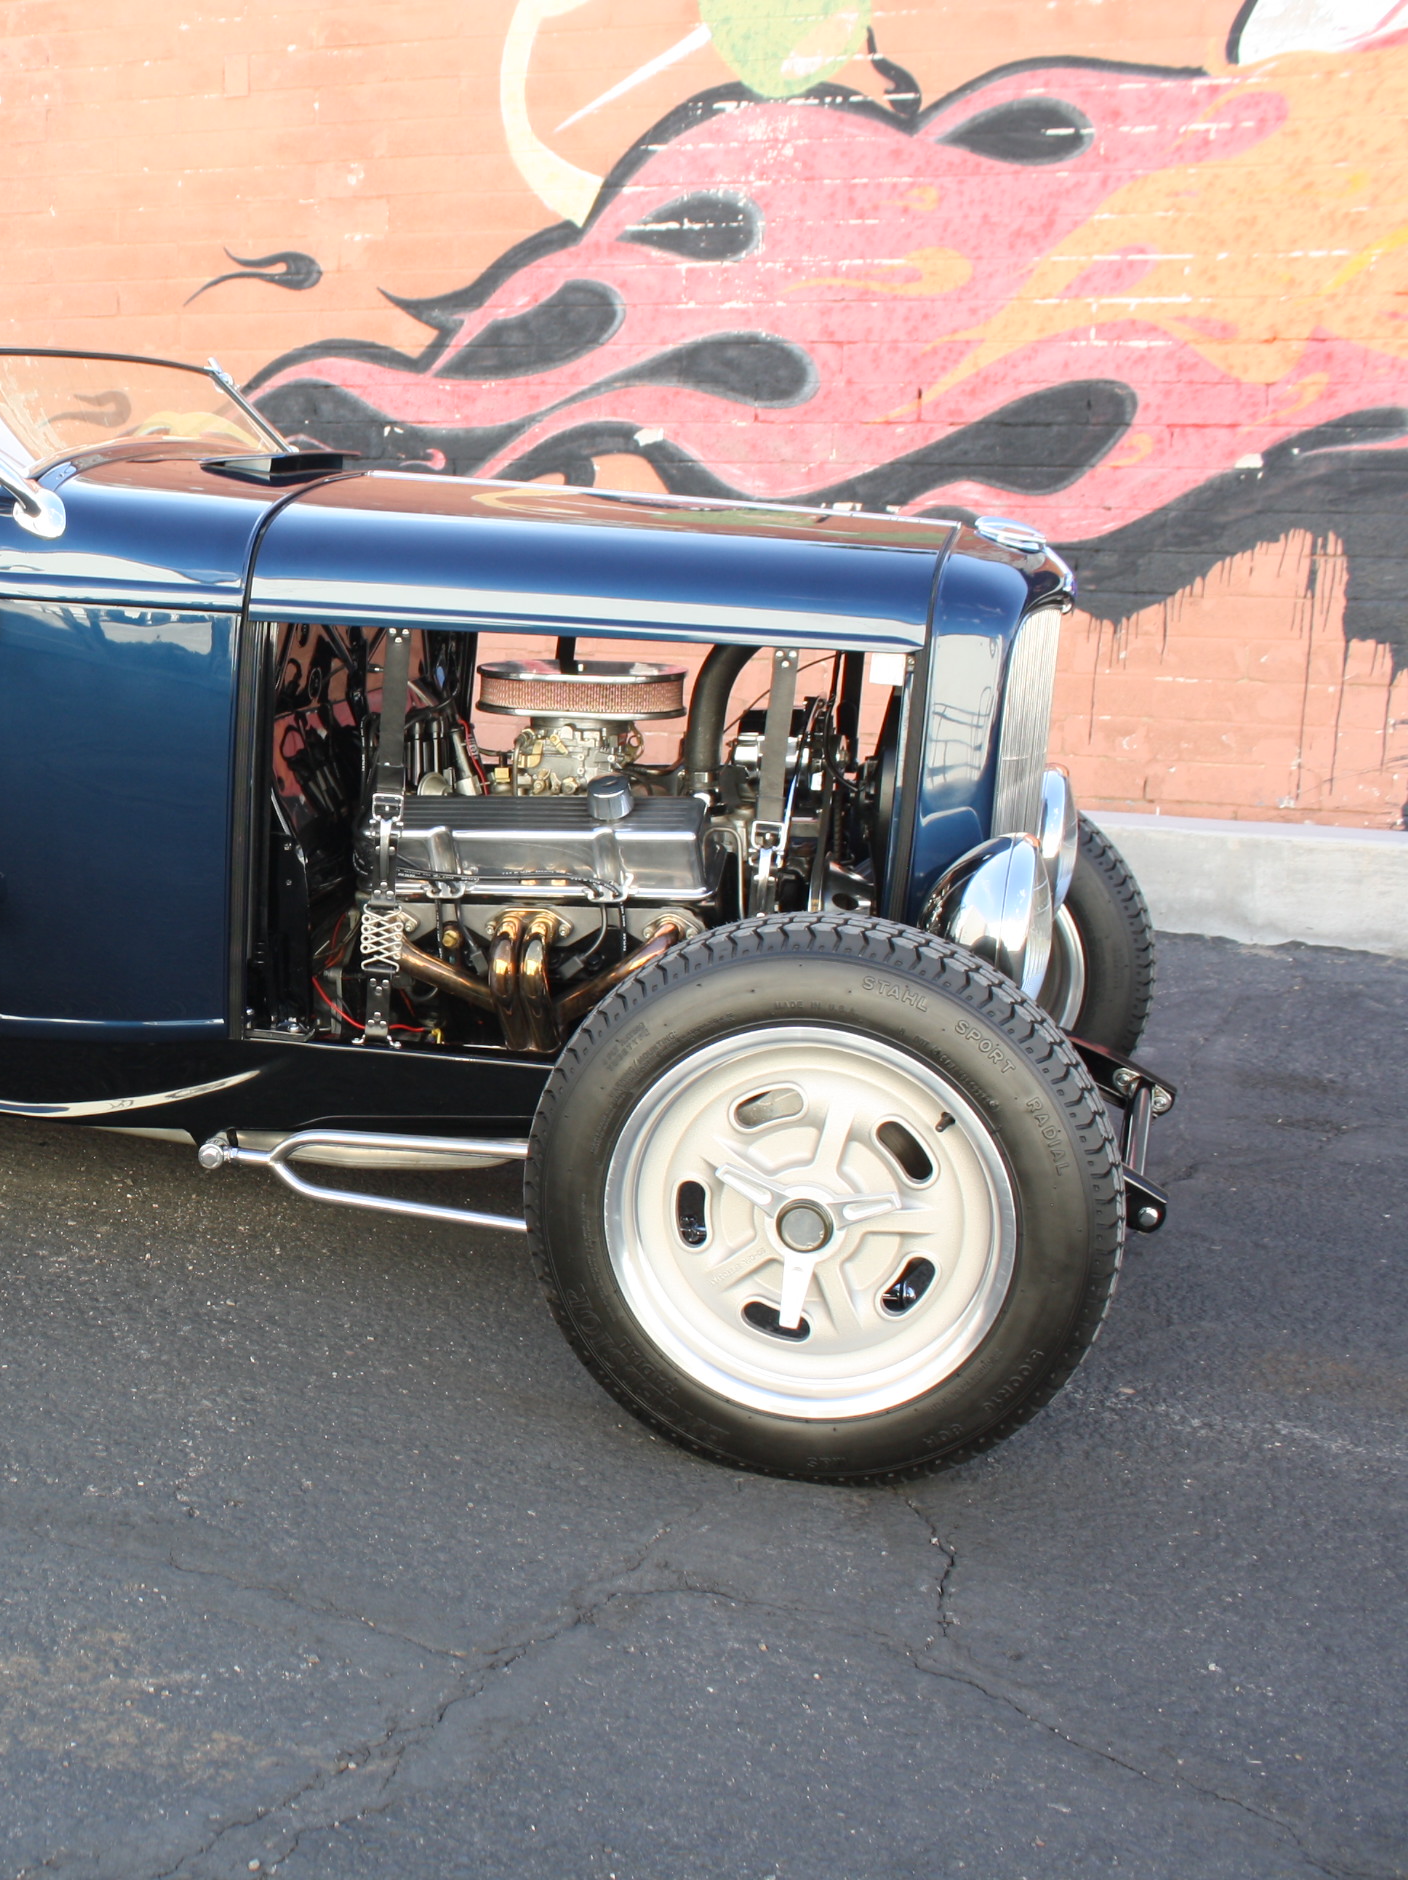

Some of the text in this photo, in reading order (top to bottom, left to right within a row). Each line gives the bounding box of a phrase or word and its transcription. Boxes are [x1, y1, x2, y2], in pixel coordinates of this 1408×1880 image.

[774, 999, 803, 1009] MADE
[810, 999, 821, 1009] IN
[862, 976, 1072, 1177] STAHL SPORT RADIAL
[616, 1335, 678, 1397] RADIAL
